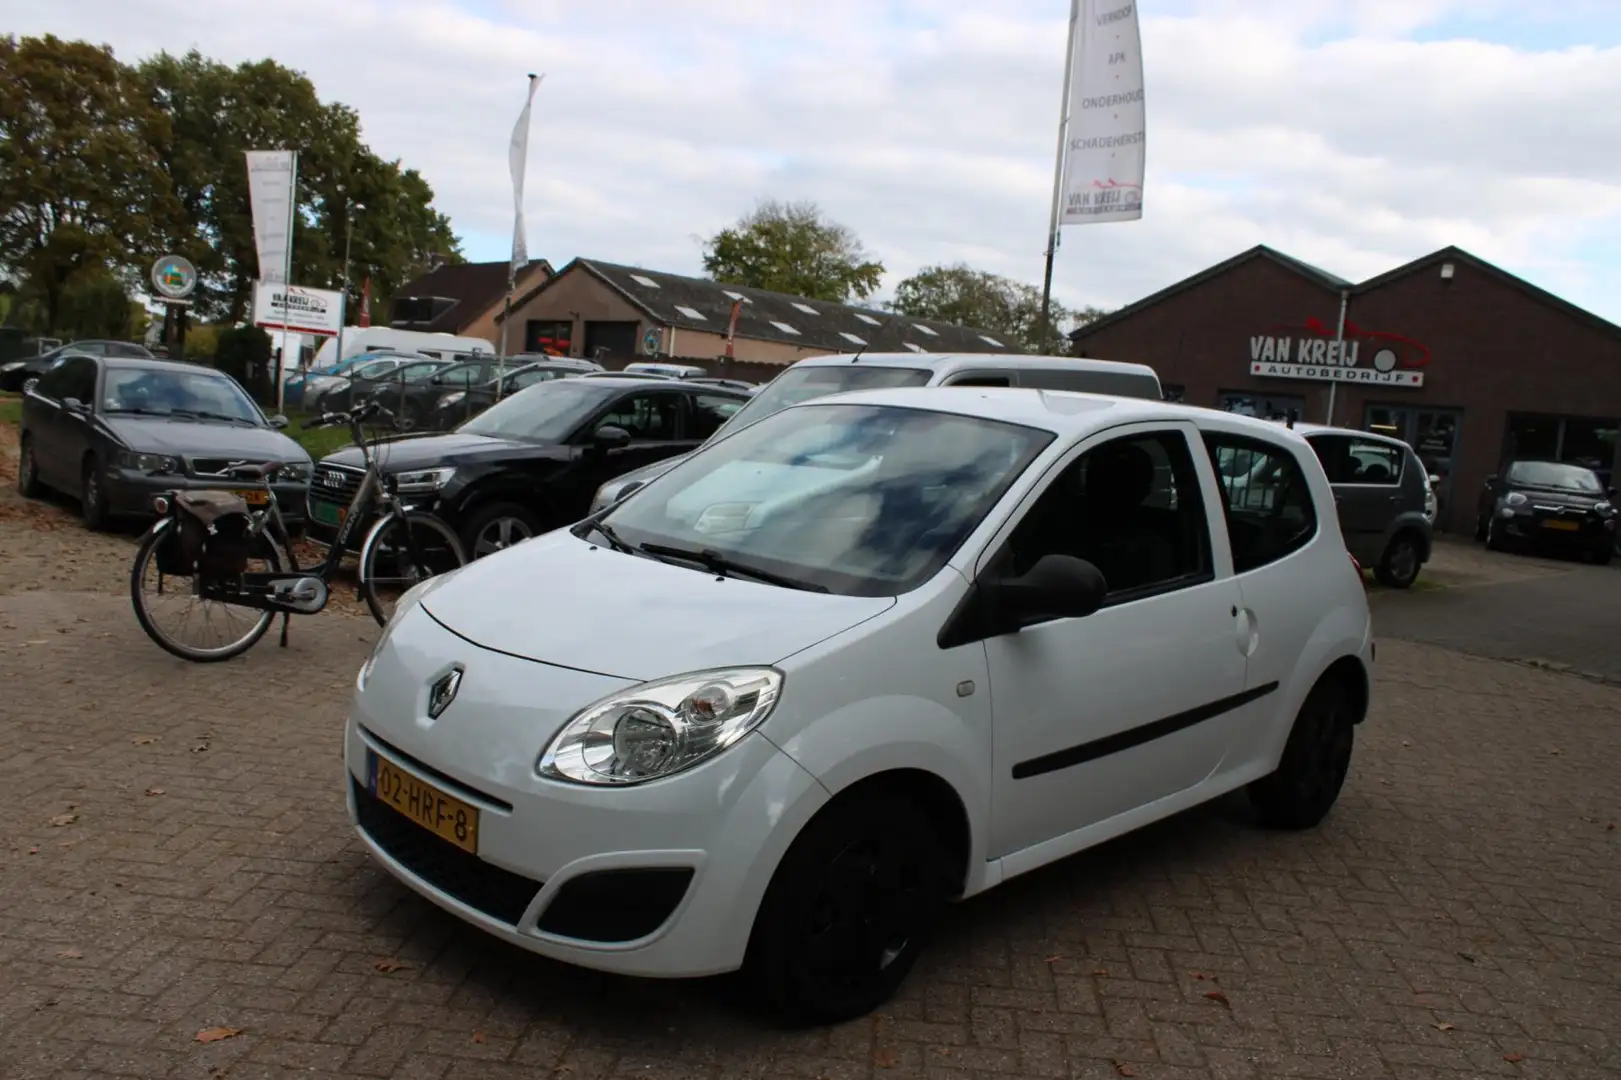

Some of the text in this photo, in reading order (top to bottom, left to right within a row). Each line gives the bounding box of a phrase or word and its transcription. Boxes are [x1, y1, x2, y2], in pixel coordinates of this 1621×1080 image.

[1068, 191, 1090, 206] VAN
[1250, 336, 1359, 367] VAN KREIJ
[1268, 365, 1405, 382] AUTOBEDRIJF
[380, 766, 467, 842] 02-HRF-8
